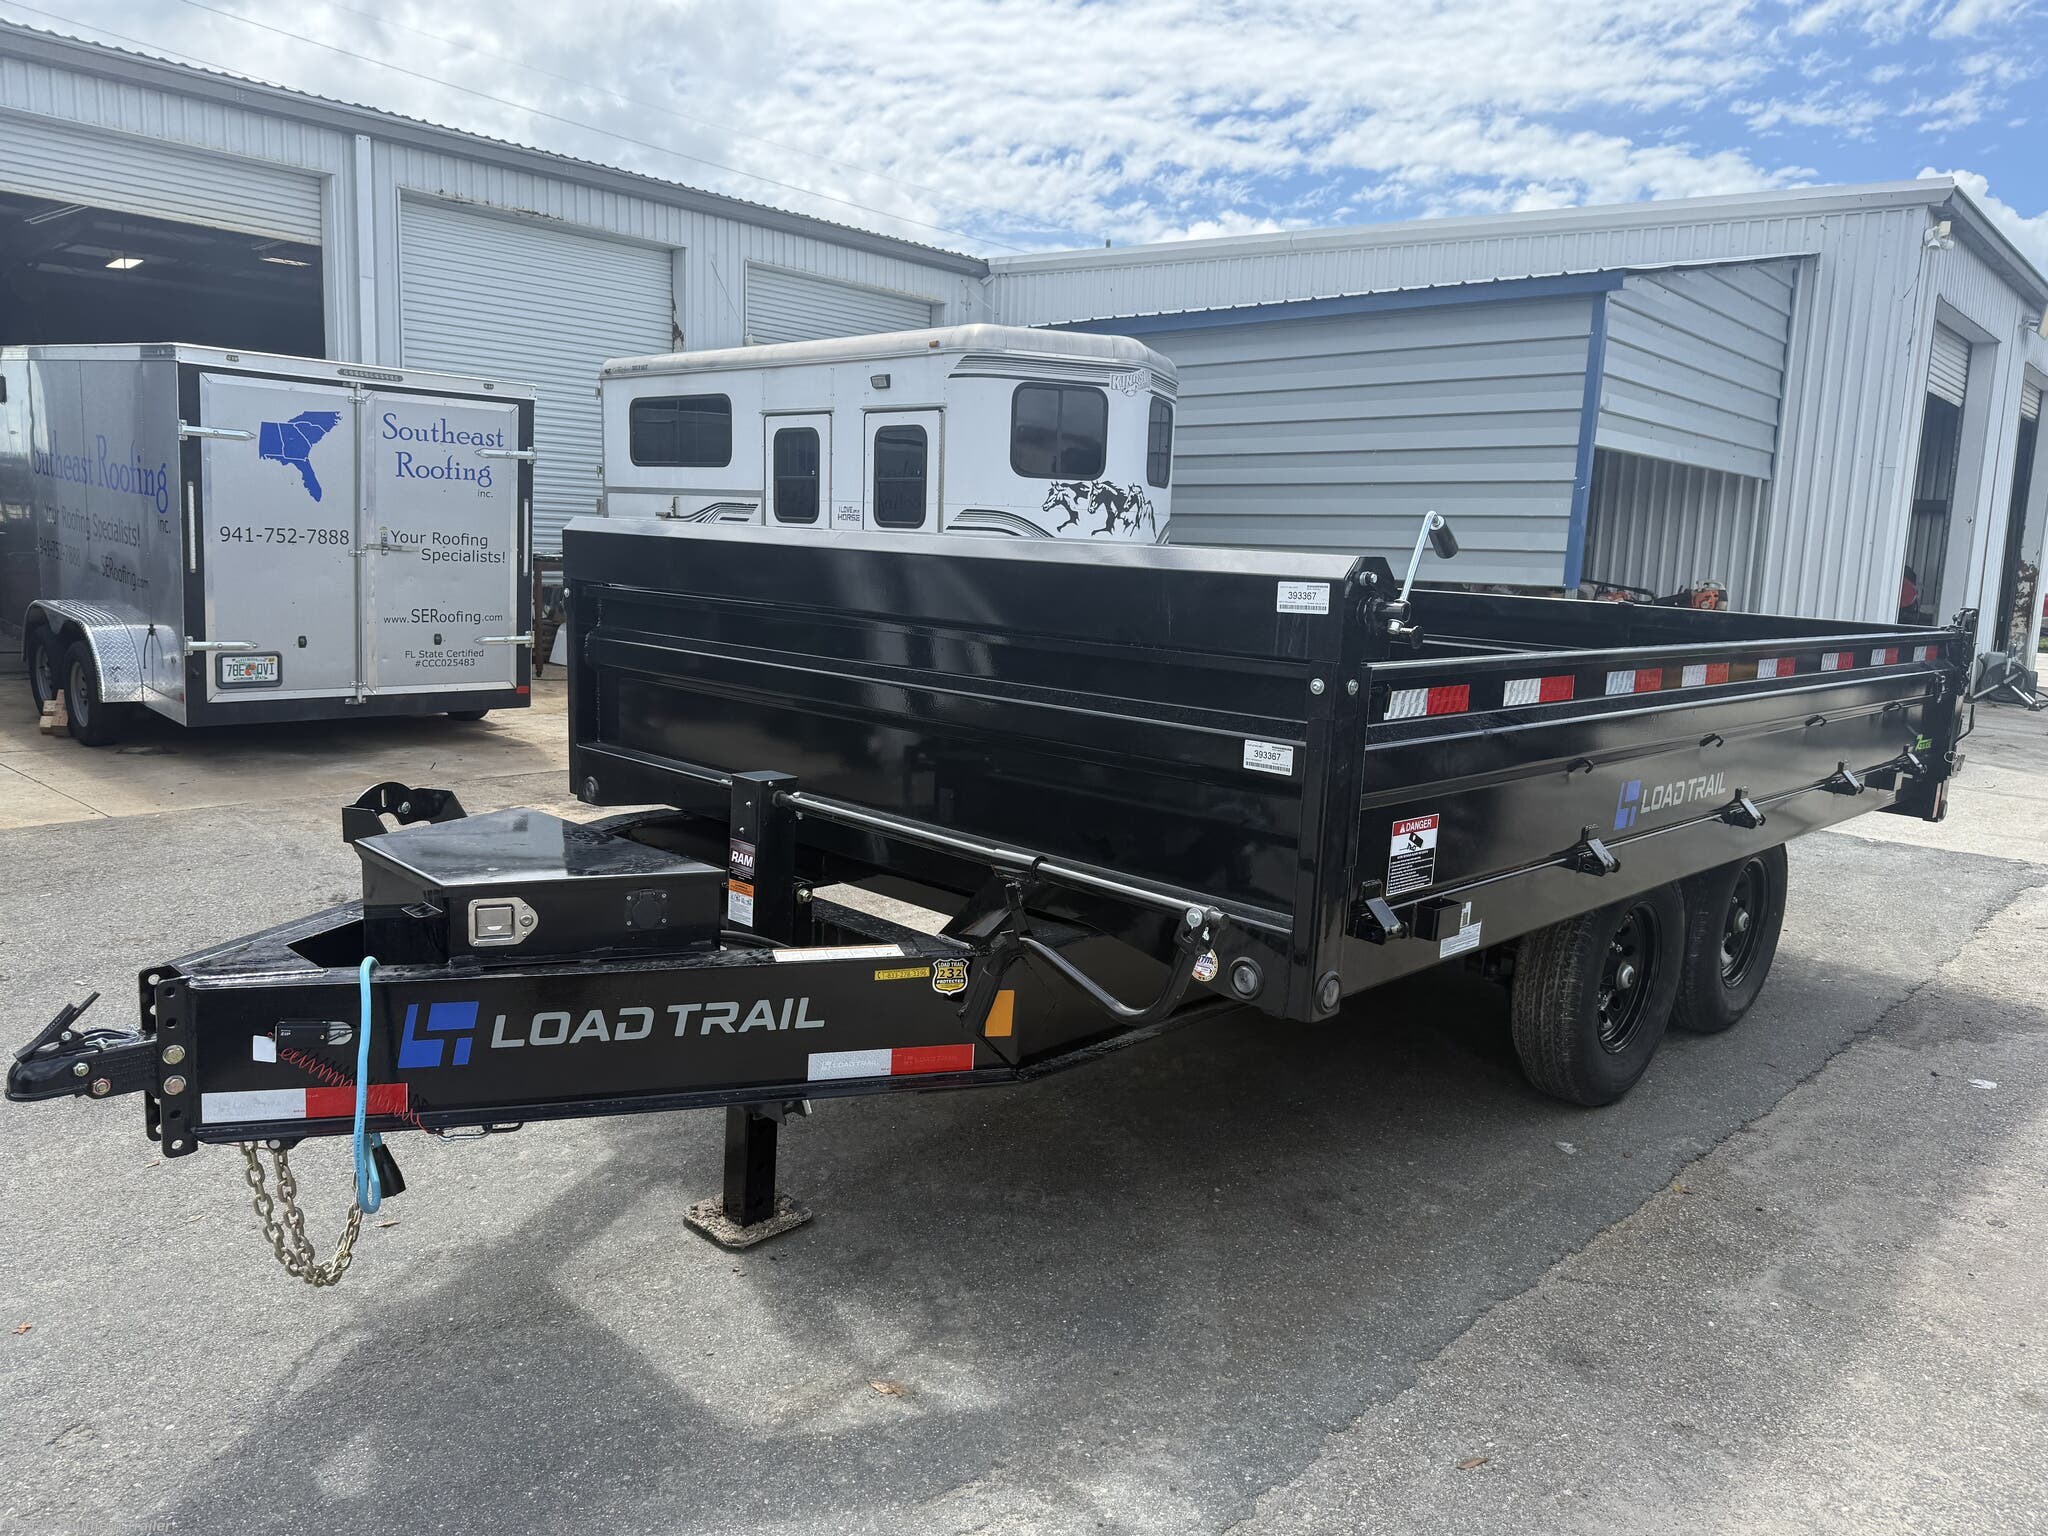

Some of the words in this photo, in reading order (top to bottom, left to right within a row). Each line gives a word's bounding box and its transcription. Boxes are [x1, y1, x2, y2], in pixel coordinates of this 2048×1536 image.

[382, 412, 504, 448] Southeast
[96, 434, 169, 514] Roofing
[395, 451, 492, 488] Roofing
[837, 513, 861, 521] HORSE
[92, 513, 141, 549] Specialists!
[219, 525, 350, 545] 941-752-7888
[390, 530, 426, 544] Your
[432, 532, 488, 549] Roofing
[421, 548, 506, 564] Specialists!
[1287, 591, 1317, 600] 393367
[383, 608, 503, 625] www.SERoofing.com
[405, 650, 416, 658] FL
[418, 650, 443, 658] State
[446, 649, 484, 658] Certified
[415, 659, 475, 667] #CCC025483
[1254, 750, 1281, 761] 393367
[1640, 780, 1686, 814] LOAD
[1687, 771, 1726, 803] TRAIL
[1406, 818, 1432, 832] DANGER
[731, 850, 754, 868] RAM
[939, 968, 962, 979] 232
[490, 1006, 655, 1049] LOAD
[666, 997, 826, 1038] TRAIL
